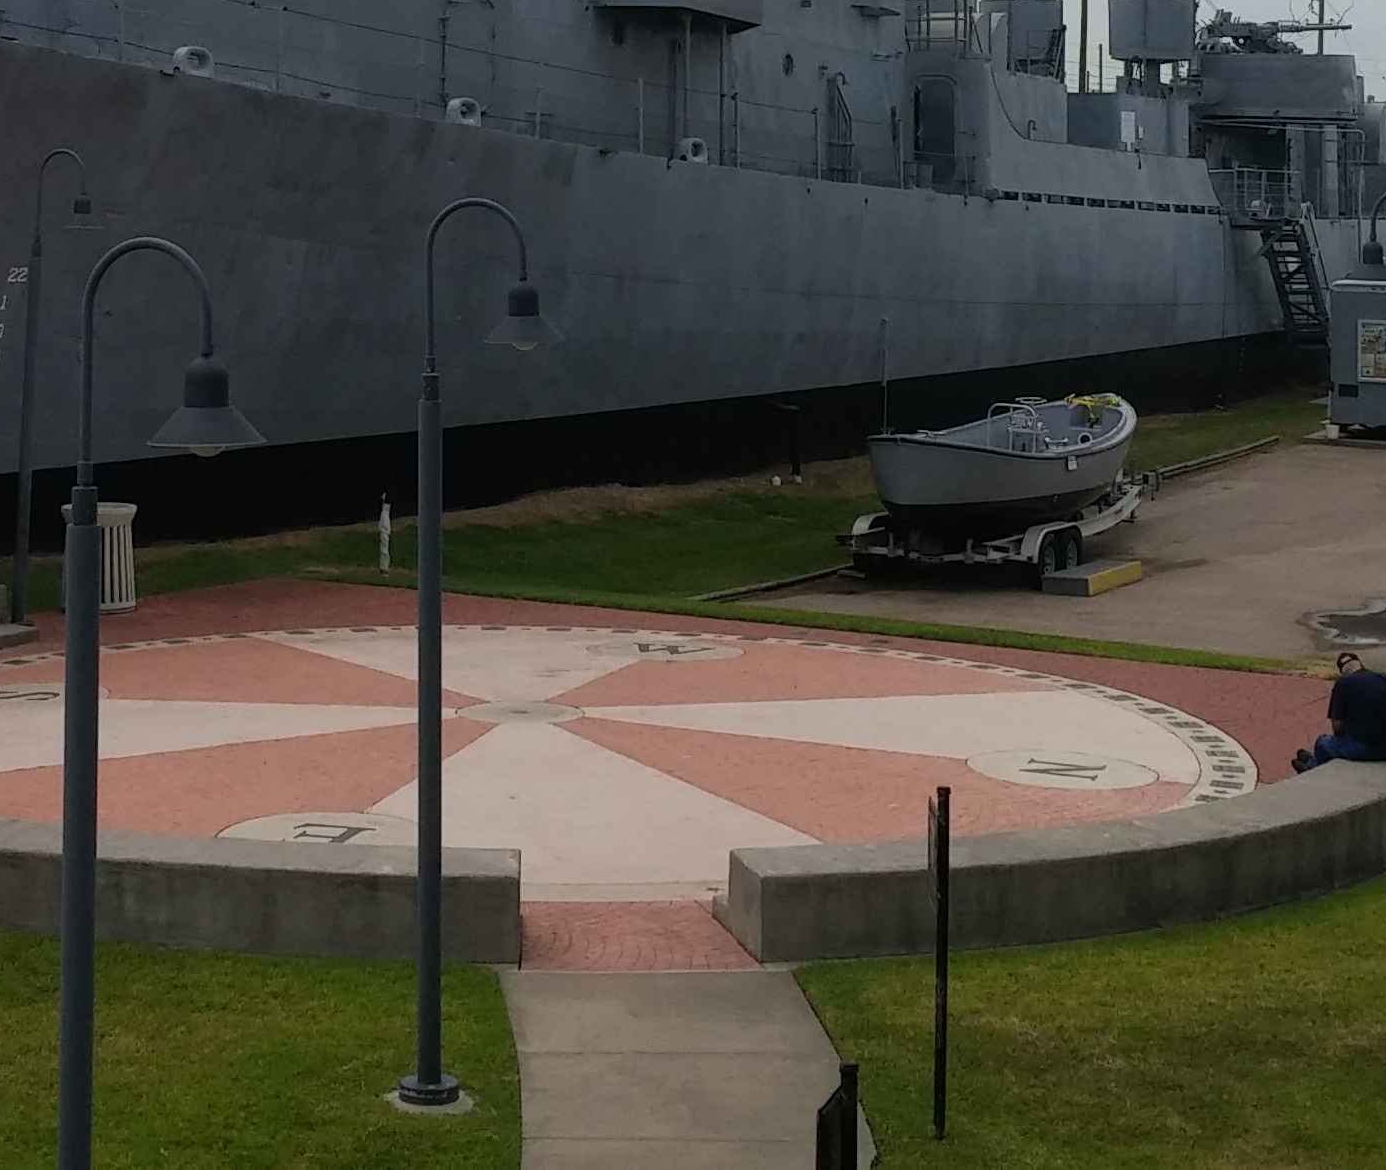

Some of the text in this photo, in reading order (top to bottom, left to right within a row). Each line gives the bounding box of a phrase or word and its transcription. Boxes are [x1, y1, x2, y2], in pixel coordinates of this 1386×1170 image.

[7, 267, 28, 283] 22
[0, 295, 8, 310] 1
[632, 642, 716, 655] W
[1018, 757, 1107, 781] N
